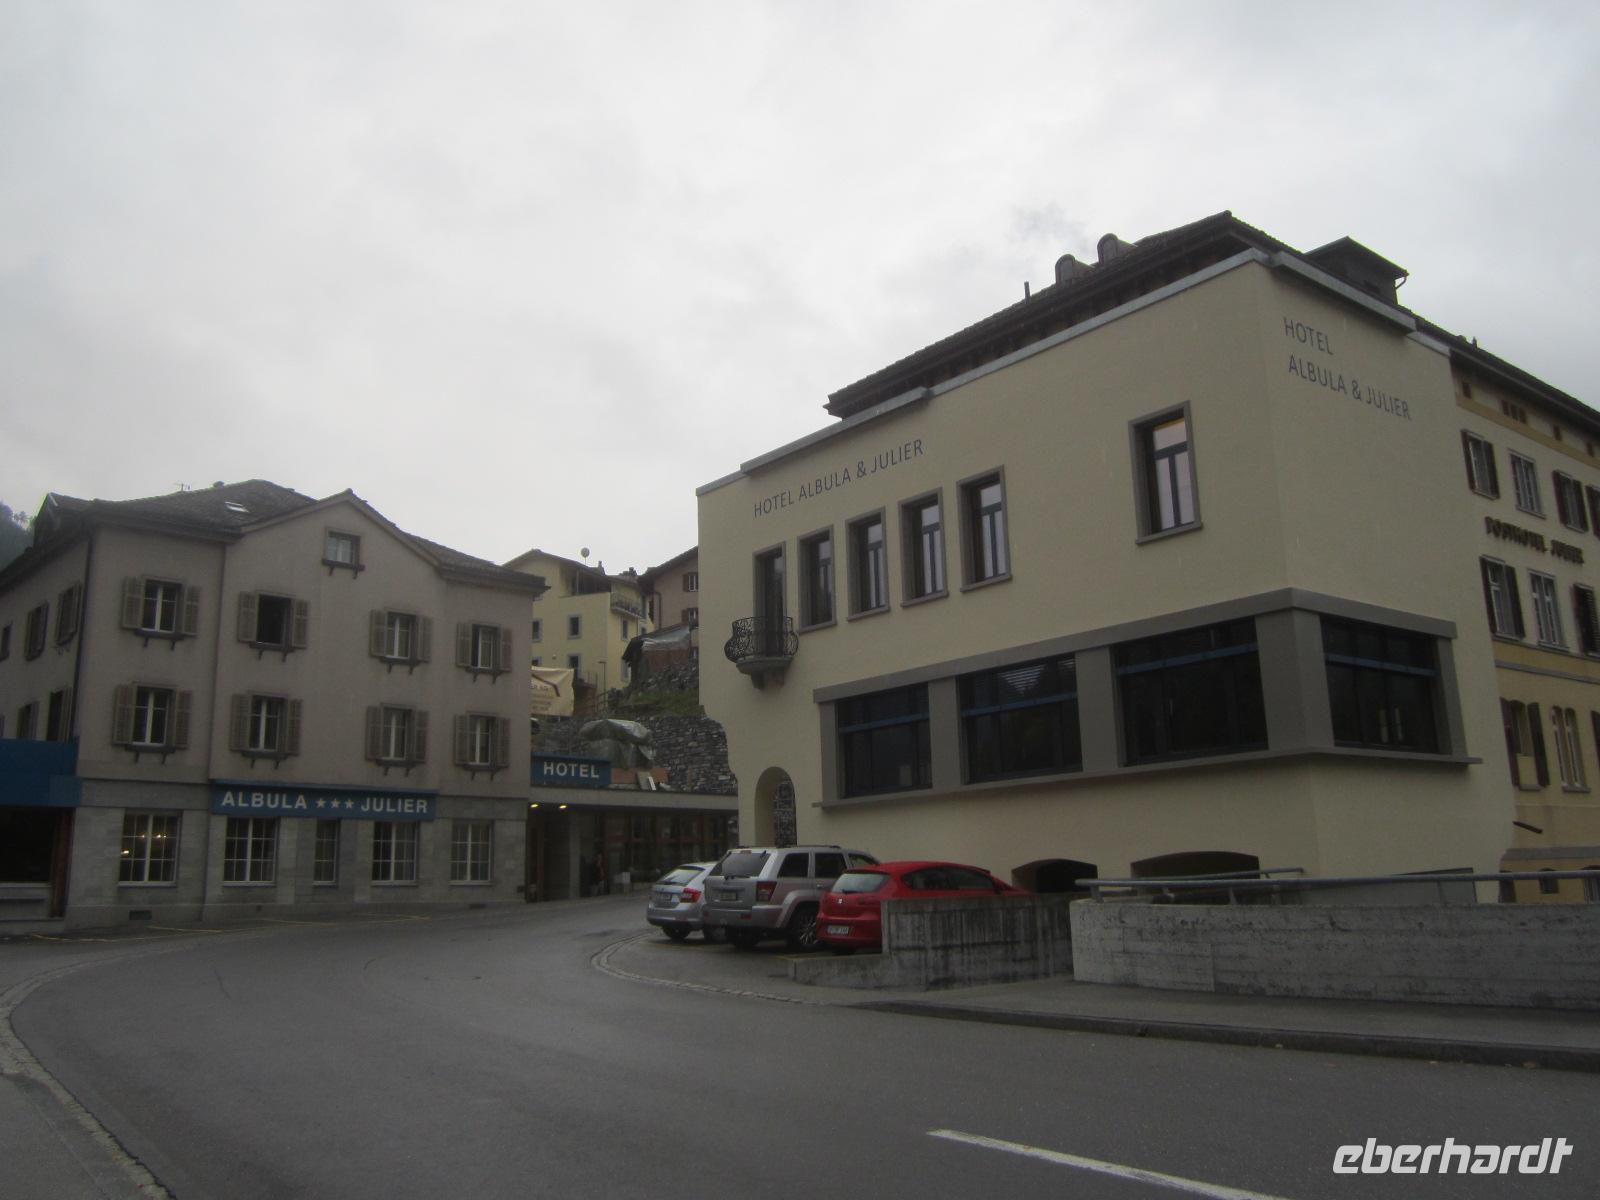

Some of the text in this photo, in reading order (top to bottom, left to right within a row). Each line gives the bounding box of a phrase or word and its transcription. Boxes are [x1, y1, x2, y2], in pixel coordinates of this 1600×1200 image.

[1283, 316, 1334, 355] HOTEL
[1288, 353, 1411, 420] ALBULA & JULIER
[754, 438, 923, 518] HOTEL ALBULA & JULIER
[543, 761, 600, 779] HOTEL
[221, 790, 428, 814] ALBULA JULIER
